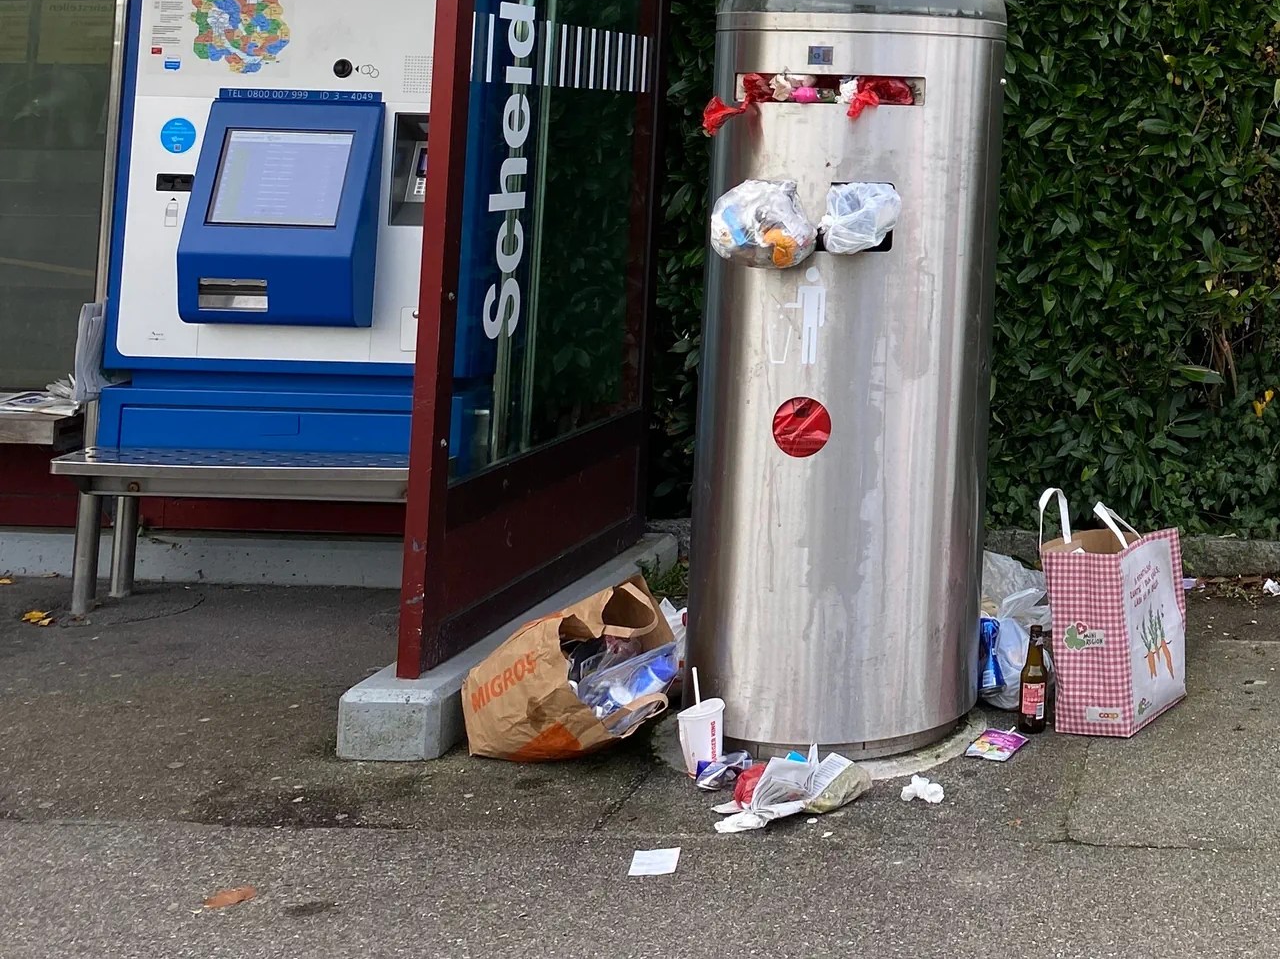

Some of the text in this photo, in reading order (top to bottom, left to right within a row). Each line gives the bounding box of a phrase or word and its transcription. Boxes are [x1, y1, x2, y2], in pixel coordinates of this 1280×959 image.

[228, 89, 241, 98] TEL
[247, 90, 268, 98] 0800
[273, 91, 288, 99] 007
[292, 91, 308, 99] 999
[320, 92, 330, 100] ID
[334, 92, 340, 100] 3
[471, 650, 537, 713] MIGROS
[1099, 712, 1119, 720] coop
